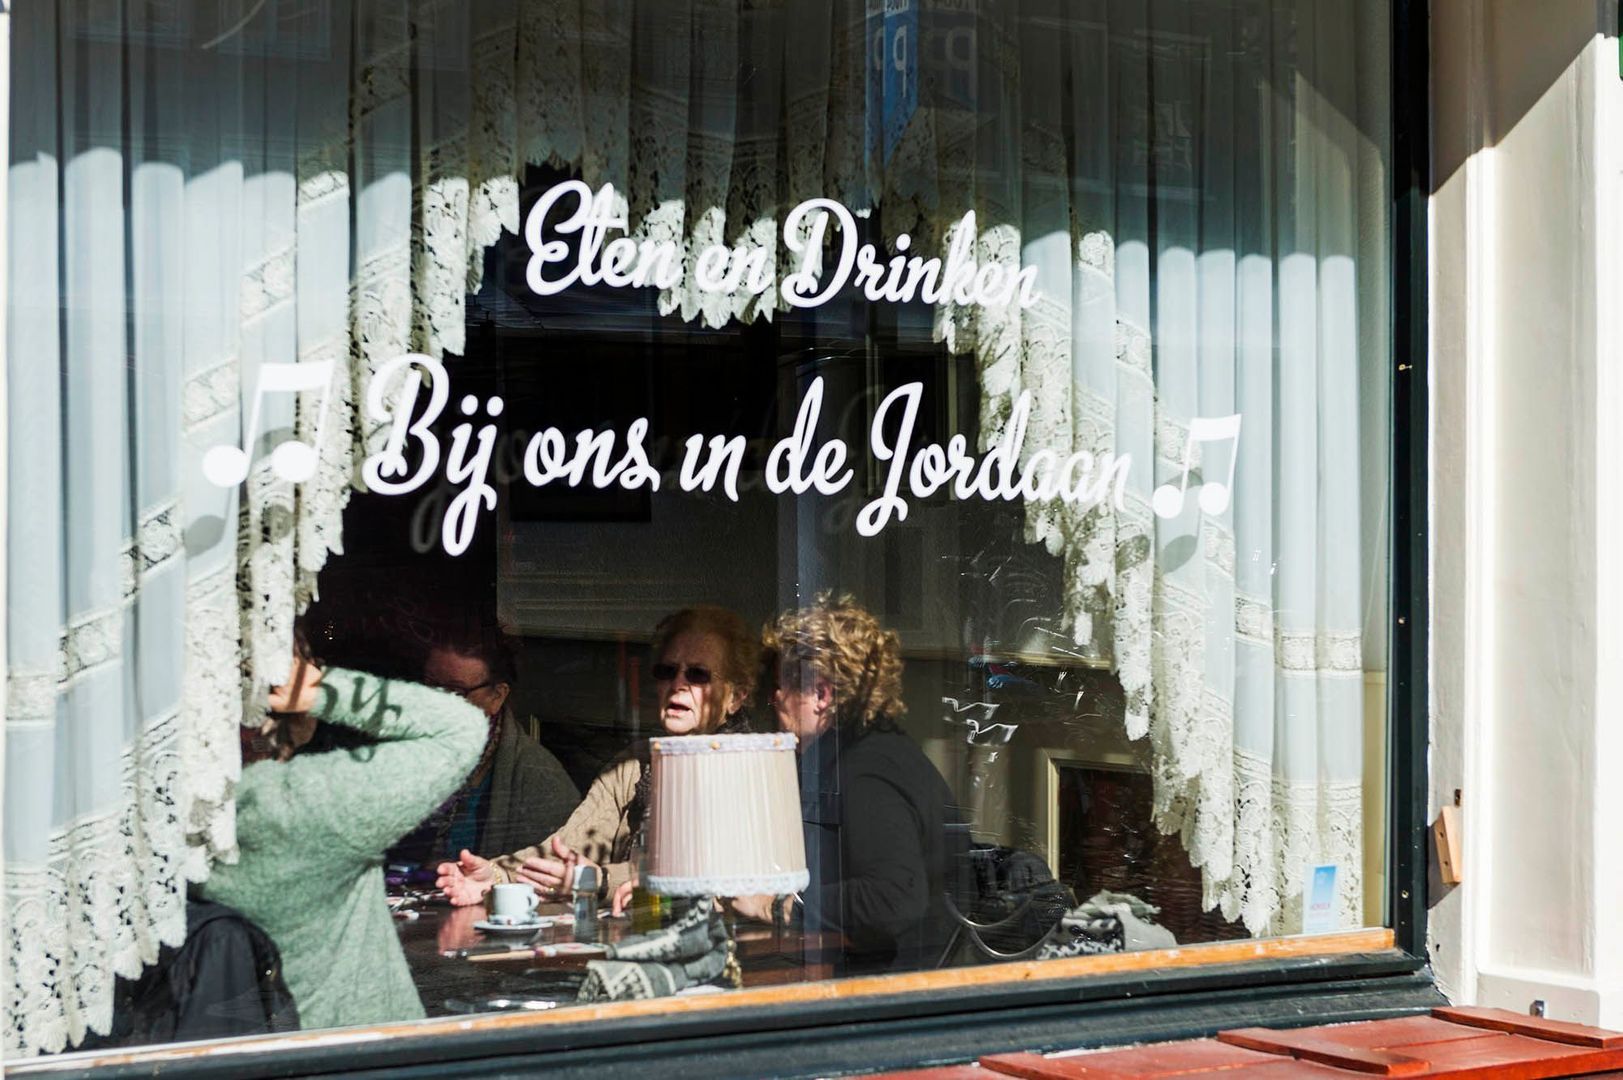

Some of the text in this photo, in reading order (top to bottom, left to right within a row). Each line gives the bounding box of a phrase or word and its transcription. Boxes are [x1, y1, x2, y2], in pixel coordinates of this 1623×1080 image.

[525, 179, 1042, 307] Eten en Drinken
[361, 353, 504, 557] Bij
[523, 417, 661, 492] ons
[765, 375, 854, 495] de
[855, 381, 1133, 537] Jordaan
